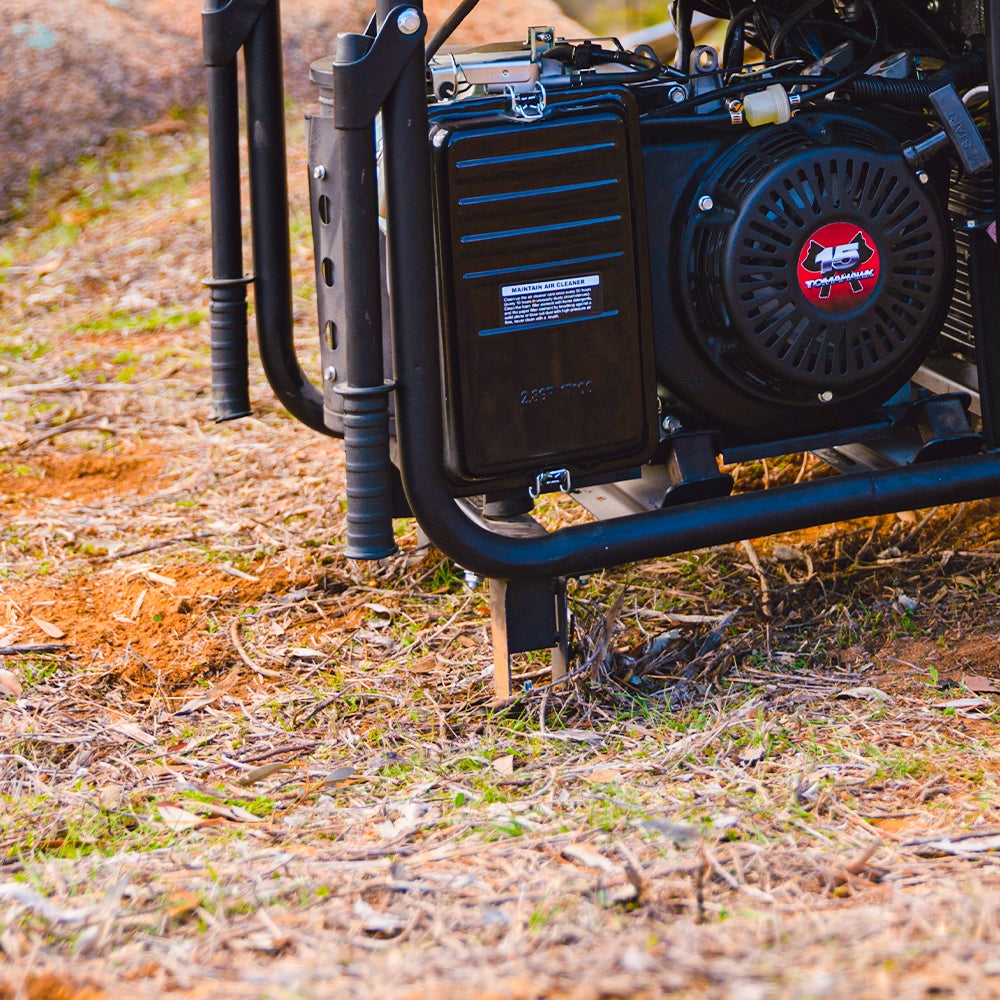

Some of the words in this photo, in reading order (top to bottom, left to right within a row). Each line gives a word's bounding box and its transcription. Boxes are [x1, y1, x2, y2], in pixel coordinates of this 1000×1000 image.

[814, 242, 860, 274] 15
[512, 284, 542, 293] MAINTAIN
[556, 279, 585, 288] CLEANER
[805, 269, 875, 289] TOMAHAWK
